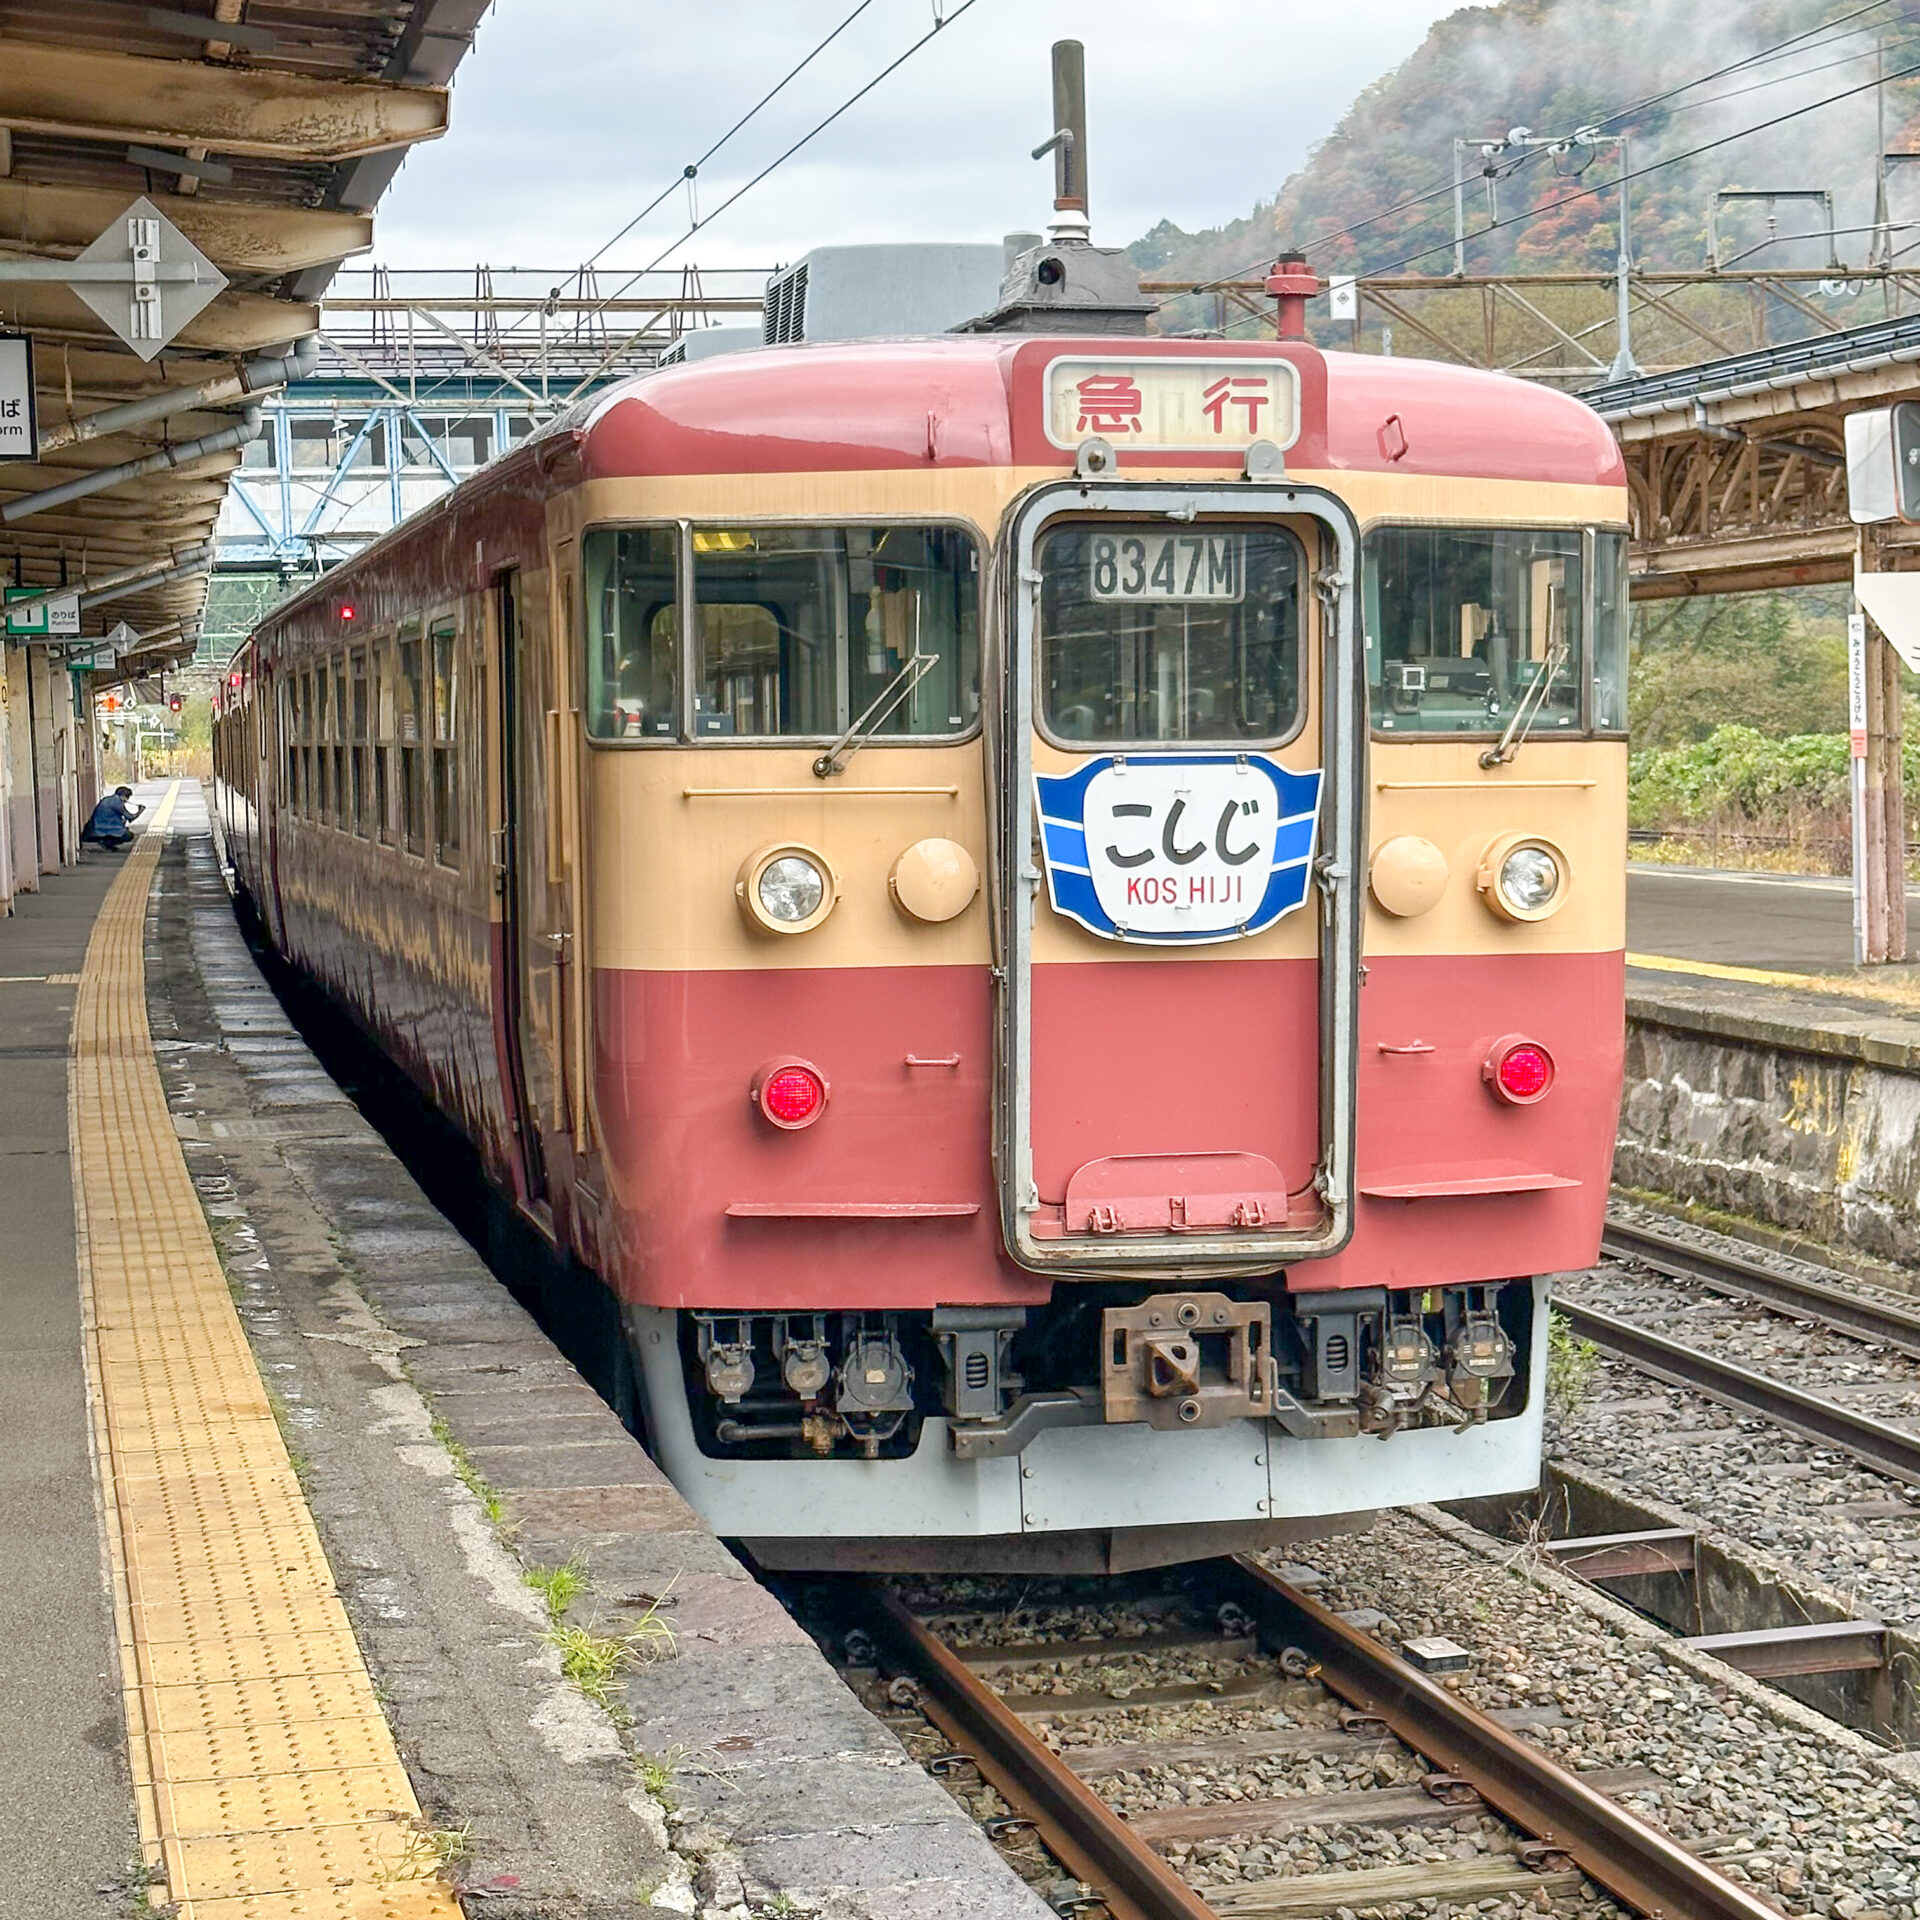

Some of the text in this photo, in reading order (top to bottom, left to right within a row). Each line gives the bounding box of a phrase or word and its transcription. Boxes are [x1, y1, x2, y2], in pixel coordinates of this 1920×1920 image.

[0, 425, 23, 435] rm
[1076, 374, 1269, 434] 急行
[1094, 538, 1233, 595] 8347M
[1105, 798, 1260, 869] こしじ
